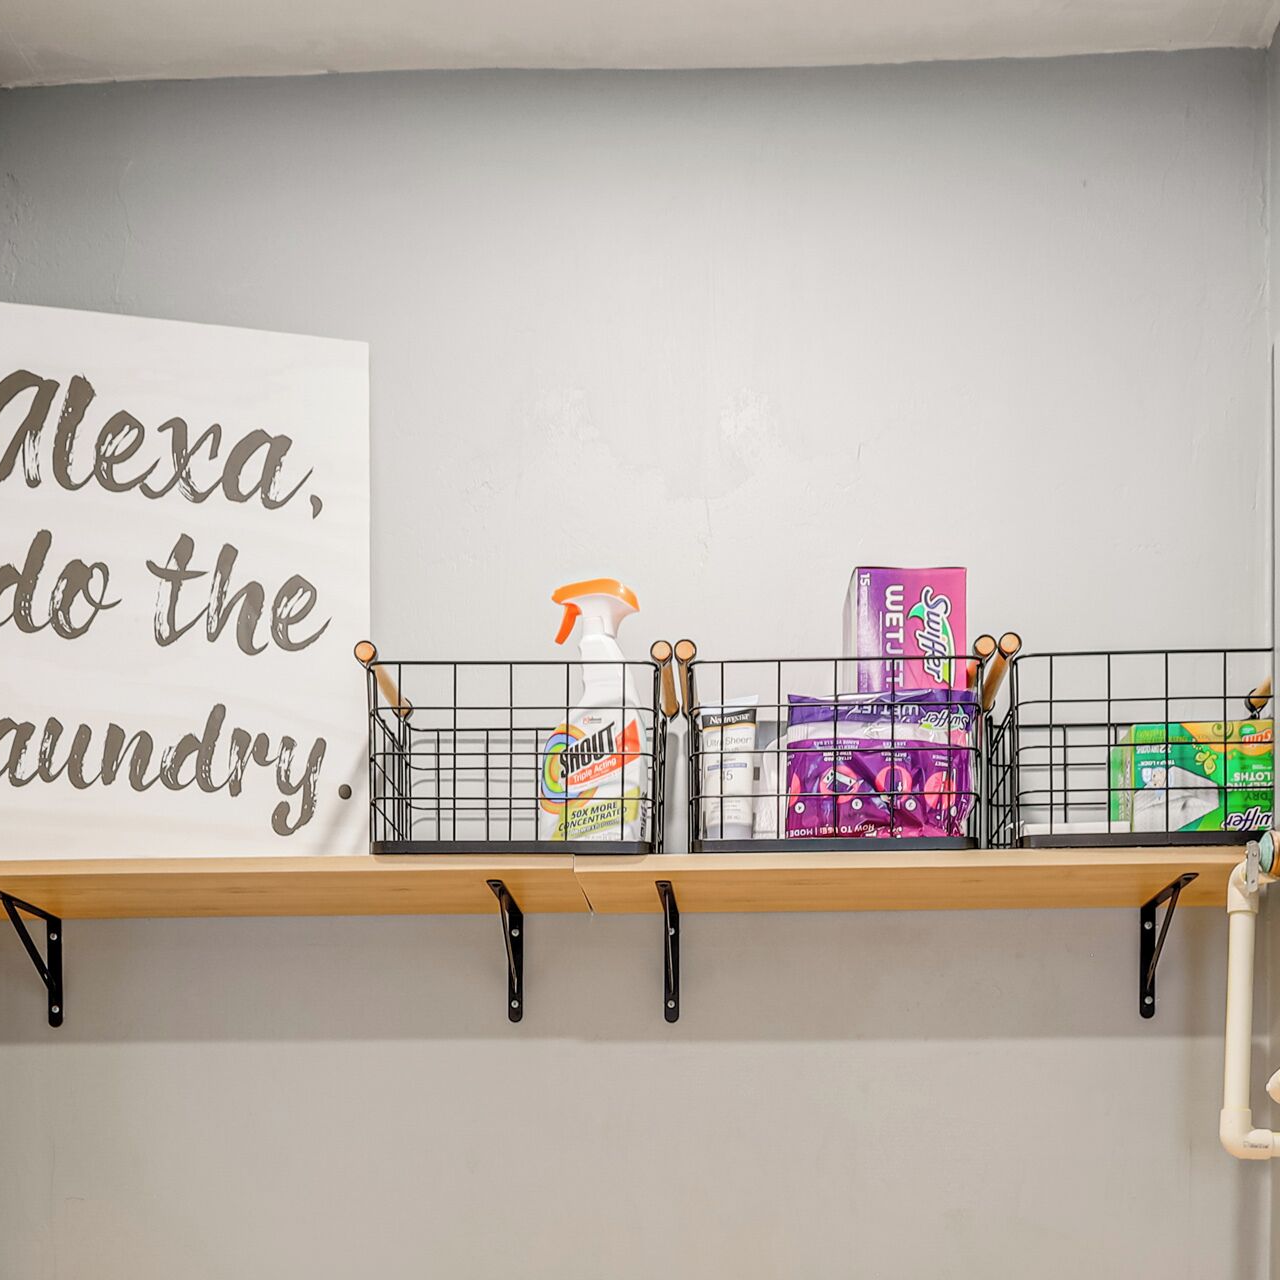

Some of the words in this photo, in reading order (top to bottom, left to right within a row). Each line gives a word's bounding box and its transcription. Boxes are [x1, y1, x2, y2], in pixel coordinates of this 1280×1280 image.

[145, 533, 333, 655] the
[860, 572, 870, 586] 15
[914, 586, 951, 683] Swiffer
[560, 720, 615, 778] SHOUT
[573, 767, 593, 783] Triple
[594, 757, 616, 773] Acting
[590, 801, 618, 815] MORE
